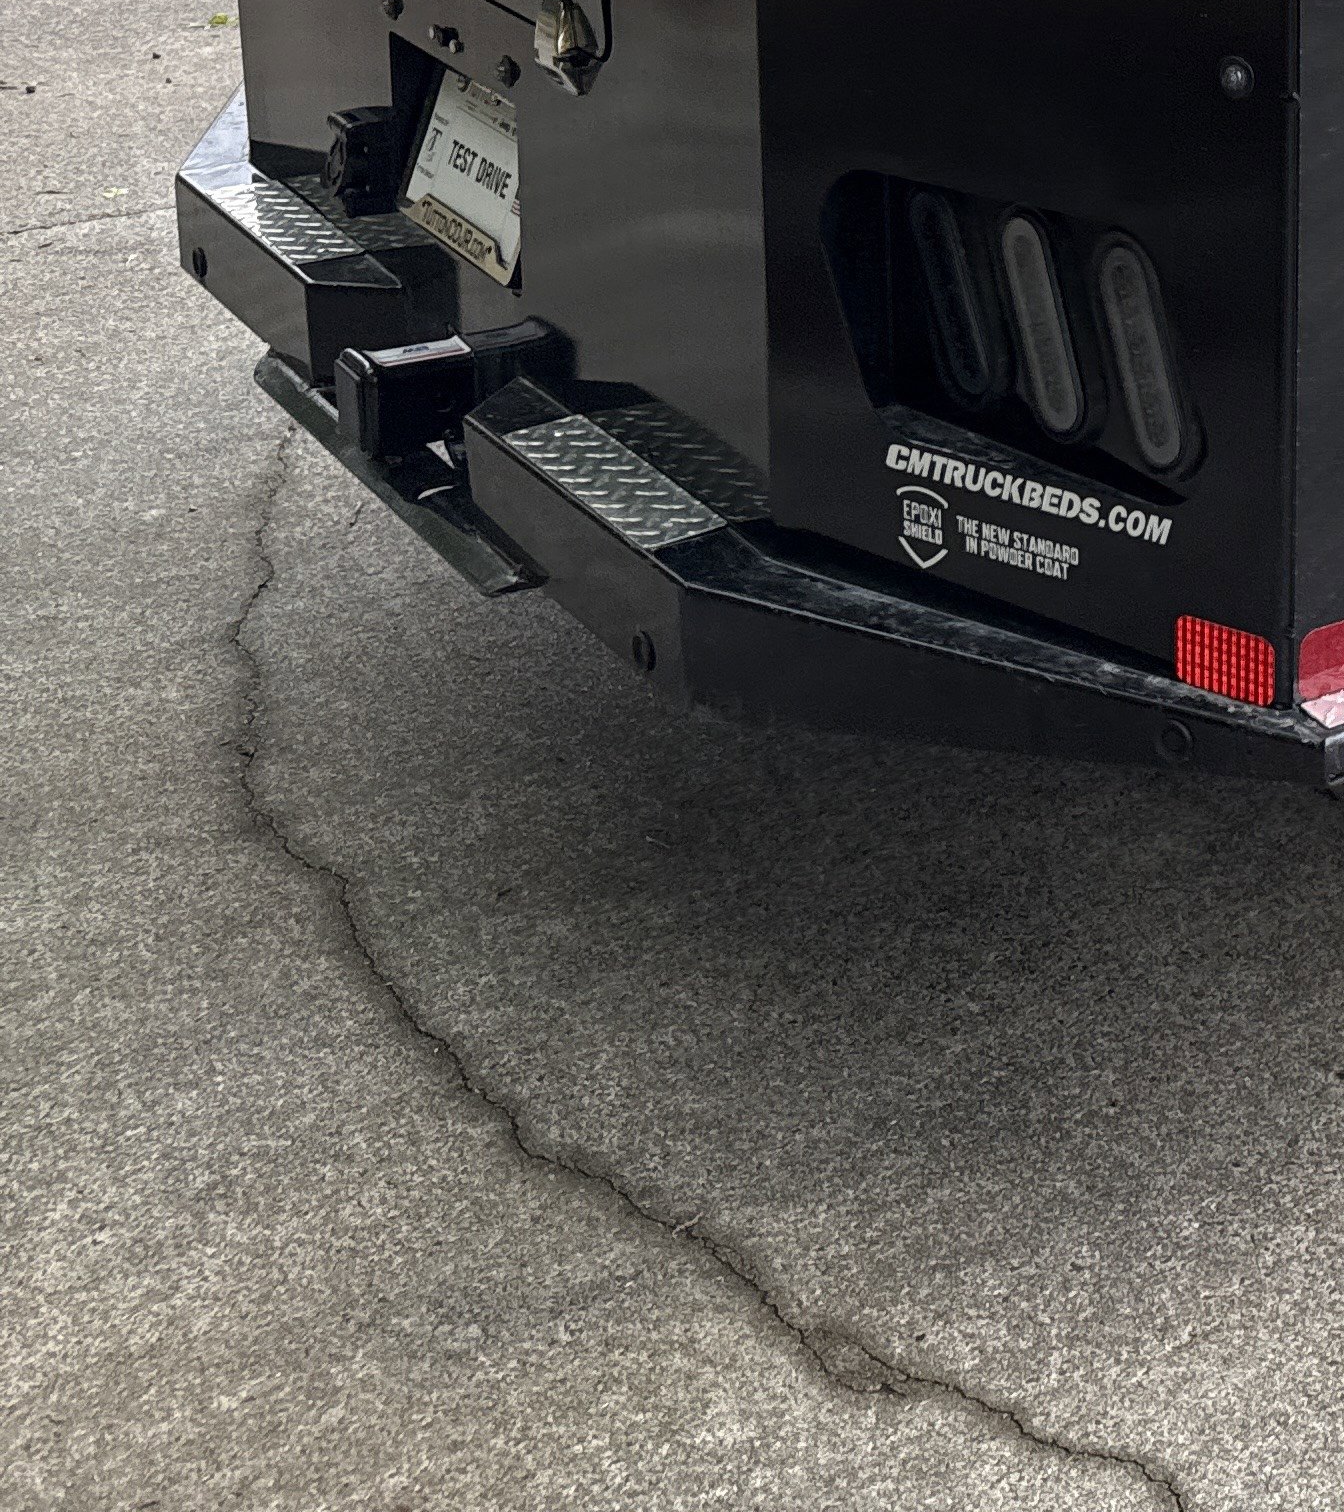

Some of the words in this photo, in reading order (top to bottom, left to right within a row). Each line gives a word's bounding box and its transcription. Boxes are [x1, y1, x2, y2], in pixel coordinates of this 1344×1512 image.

[447, 139, 479, 177] TEST
[475, 156, 513, 200] DRIVE
[885, 443, 1173, 546] CMTRUCKBEDS.COM
[903, 499, 942, 528] EPOXI
[903, 520, 943, 545] SHIELD
[956, 515, 980, 538] THE
[981, 522, 1011, 546] NEW
[1013, 531, 1080, 566] STANDARD
[965, 536, 978, 555] IN
[980, 540, 1034, 571] POWDER
[1036, 555, 1070, 581] COAT
